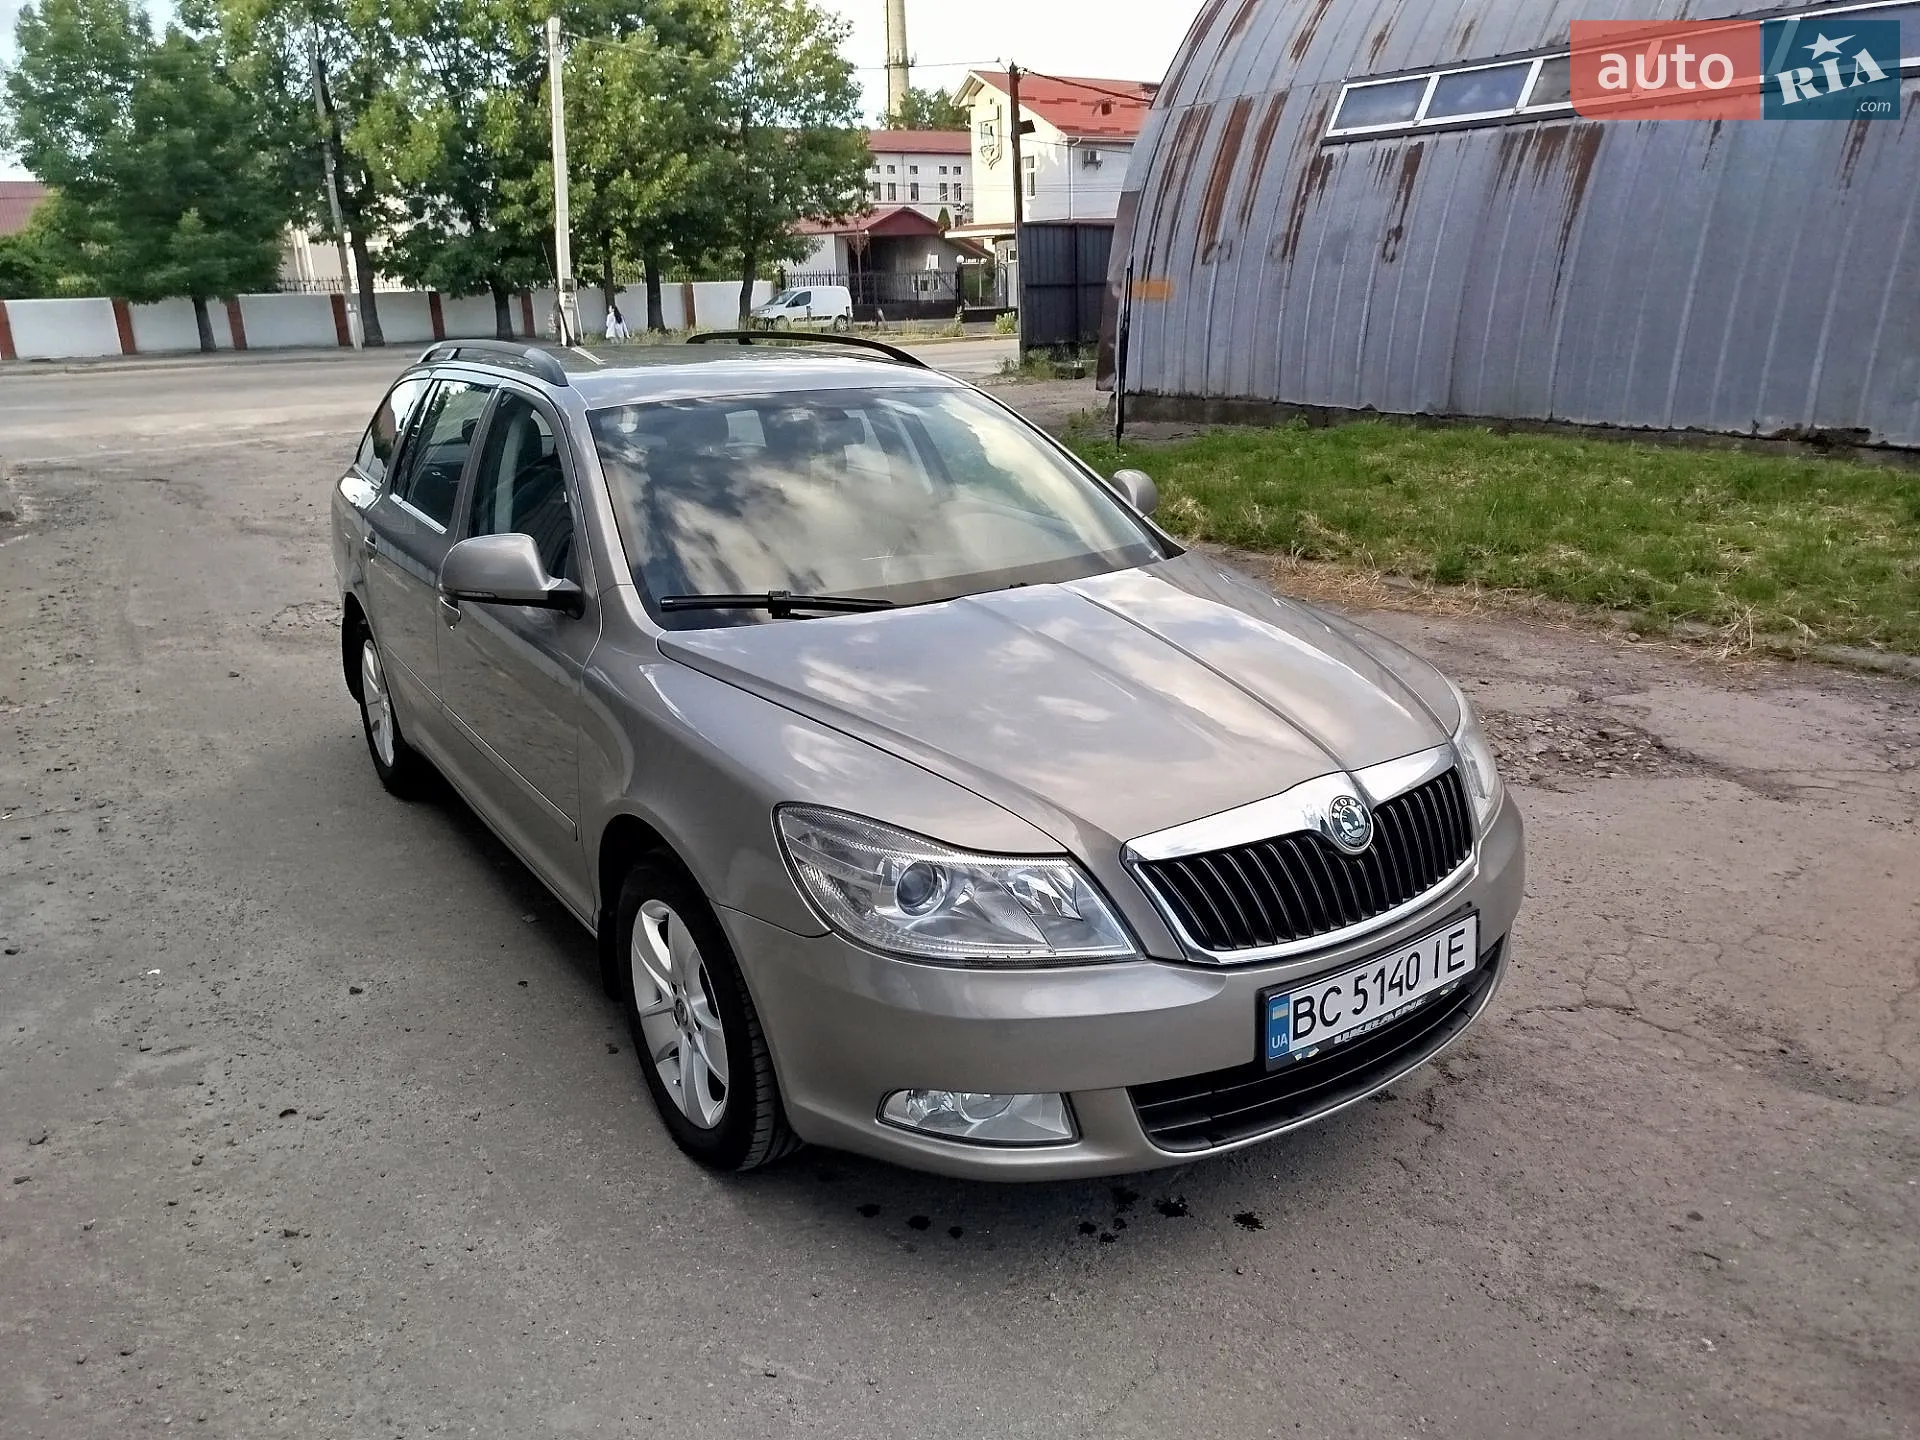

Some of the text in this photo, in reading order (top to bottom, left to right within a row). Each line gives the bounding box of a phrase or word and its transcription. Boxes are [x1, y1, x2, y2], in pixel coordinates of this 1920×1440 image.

[1292, 927, 1467, 1041] BC 5140 IE
[1271, 1036, 1288, 1049] UA
